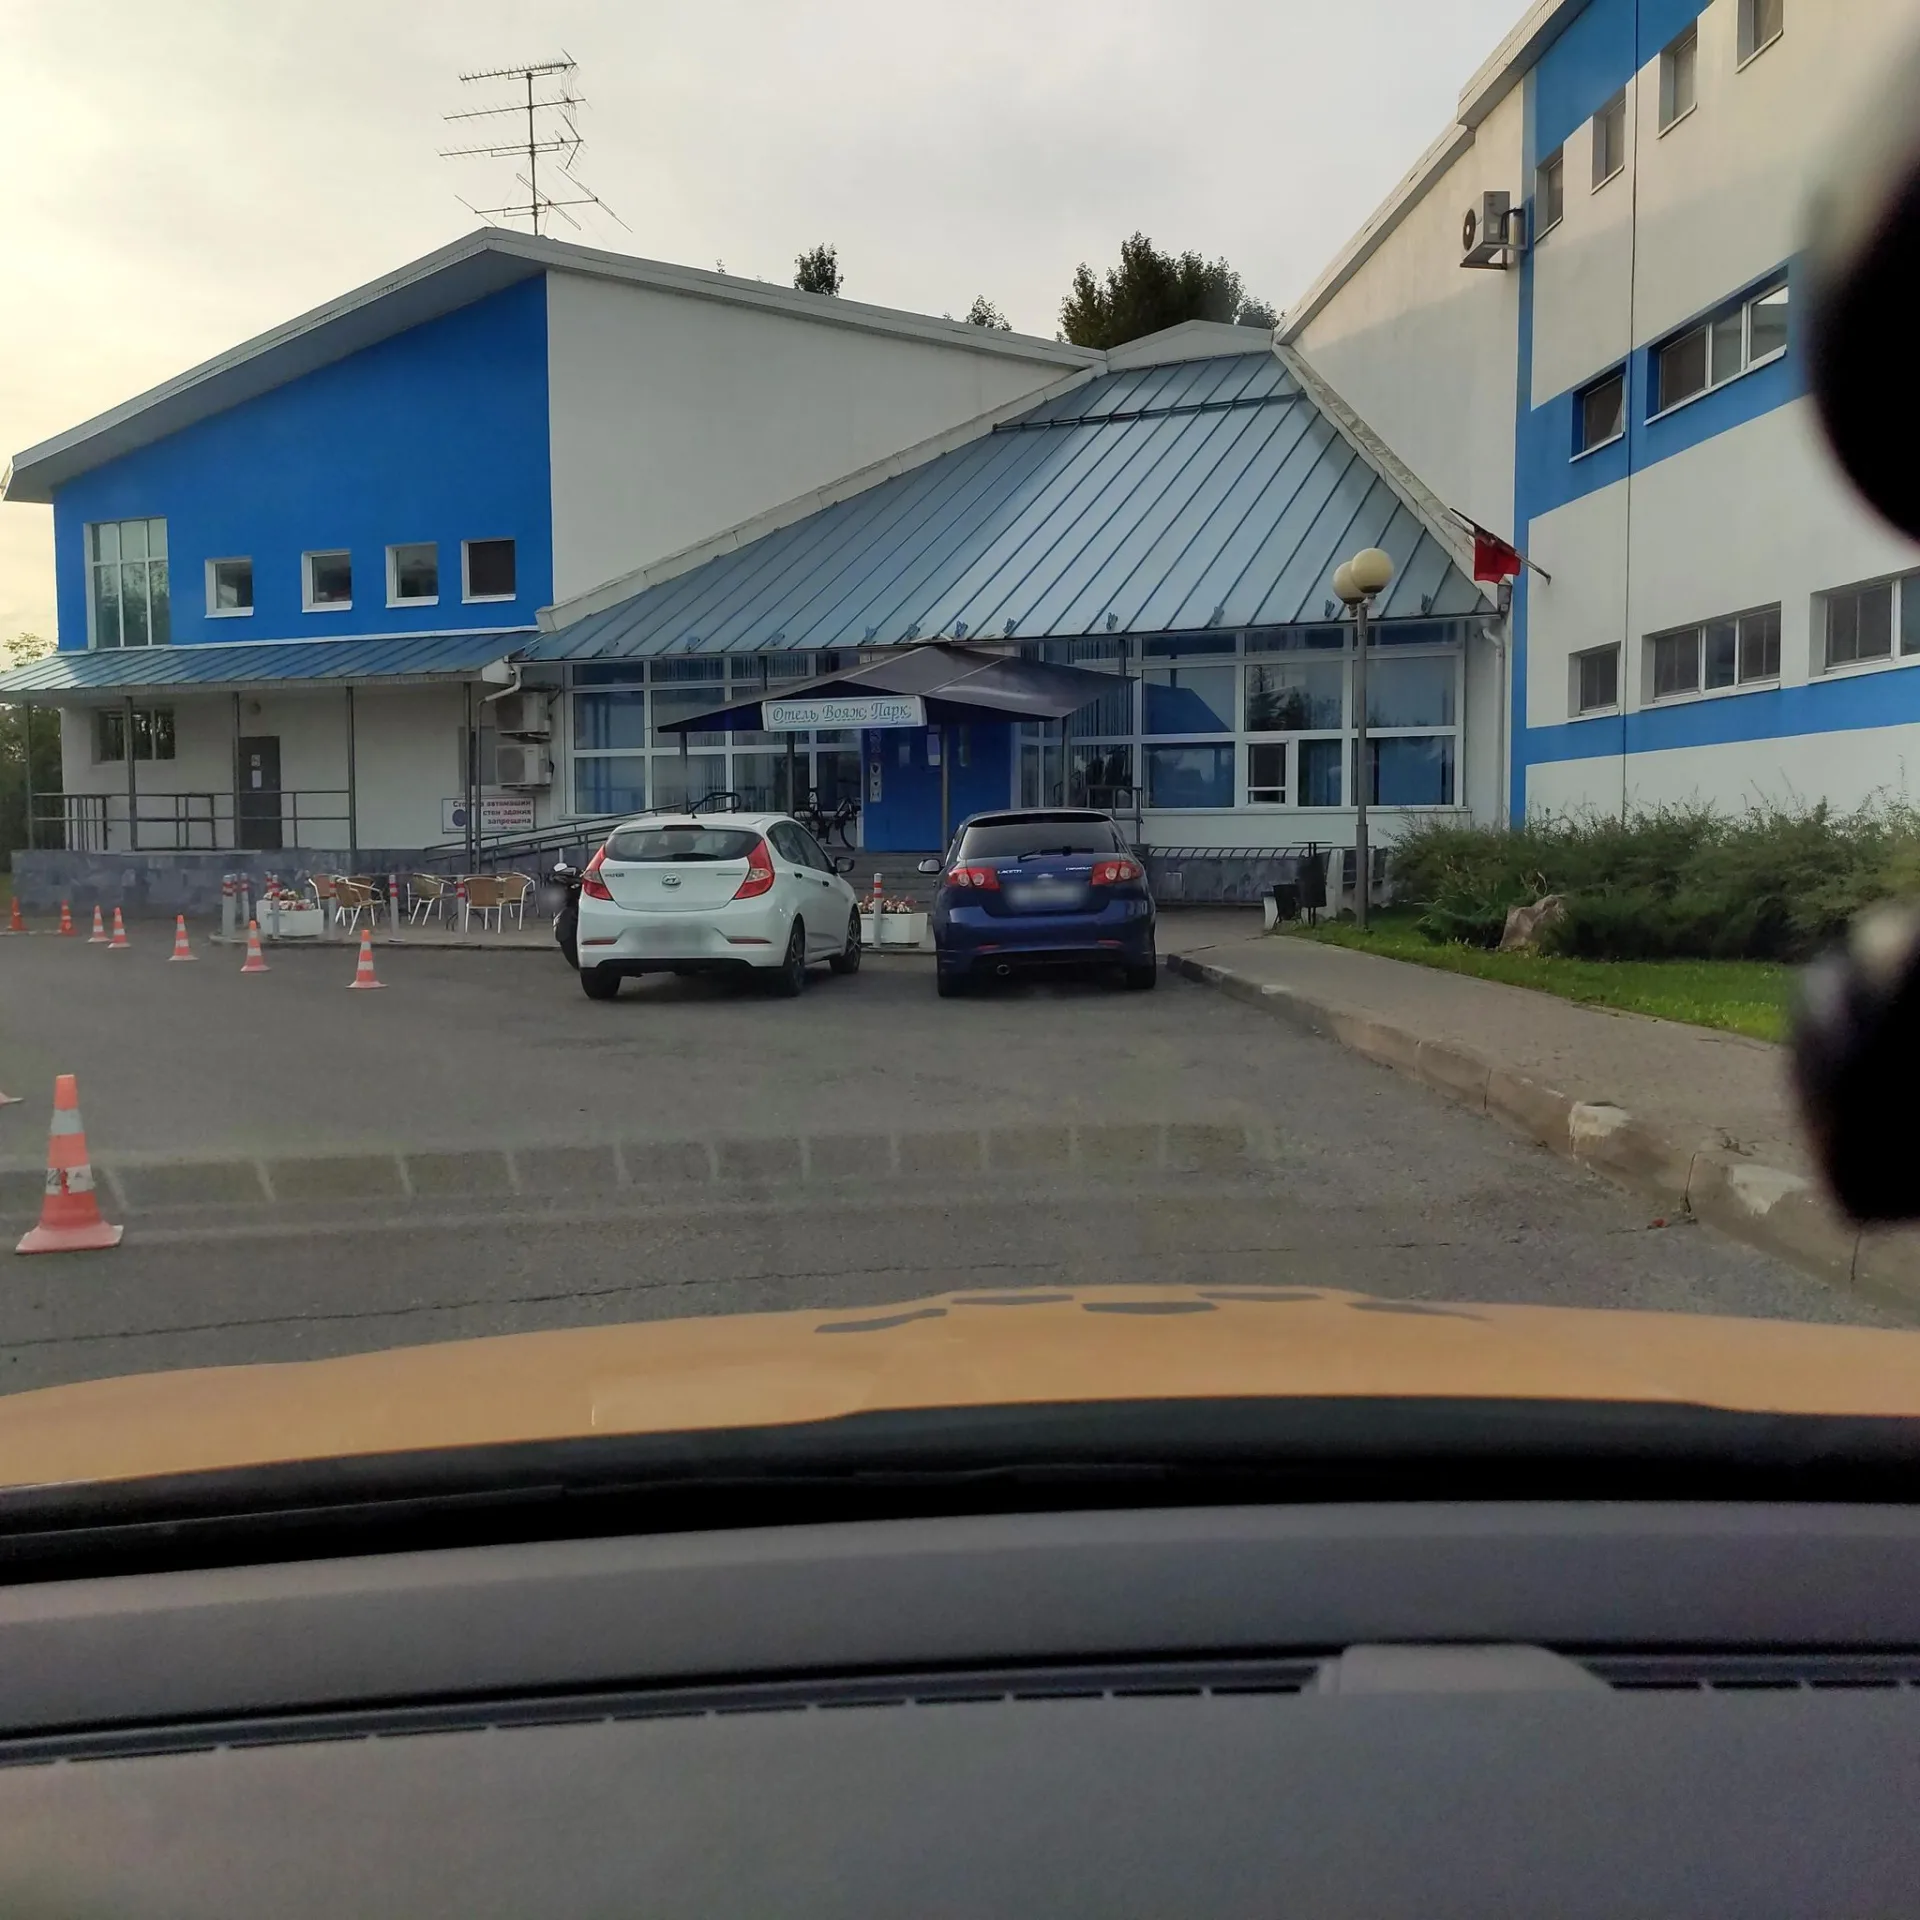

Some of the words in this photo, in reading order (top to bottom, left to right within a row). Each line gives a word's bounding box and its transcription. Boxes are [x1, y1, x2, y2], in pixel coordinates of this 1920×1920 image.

[773, 706, 819, 724] Отель
[822, 704, 868, 722] Вояж
[870, 702, 912, 725] Парк
